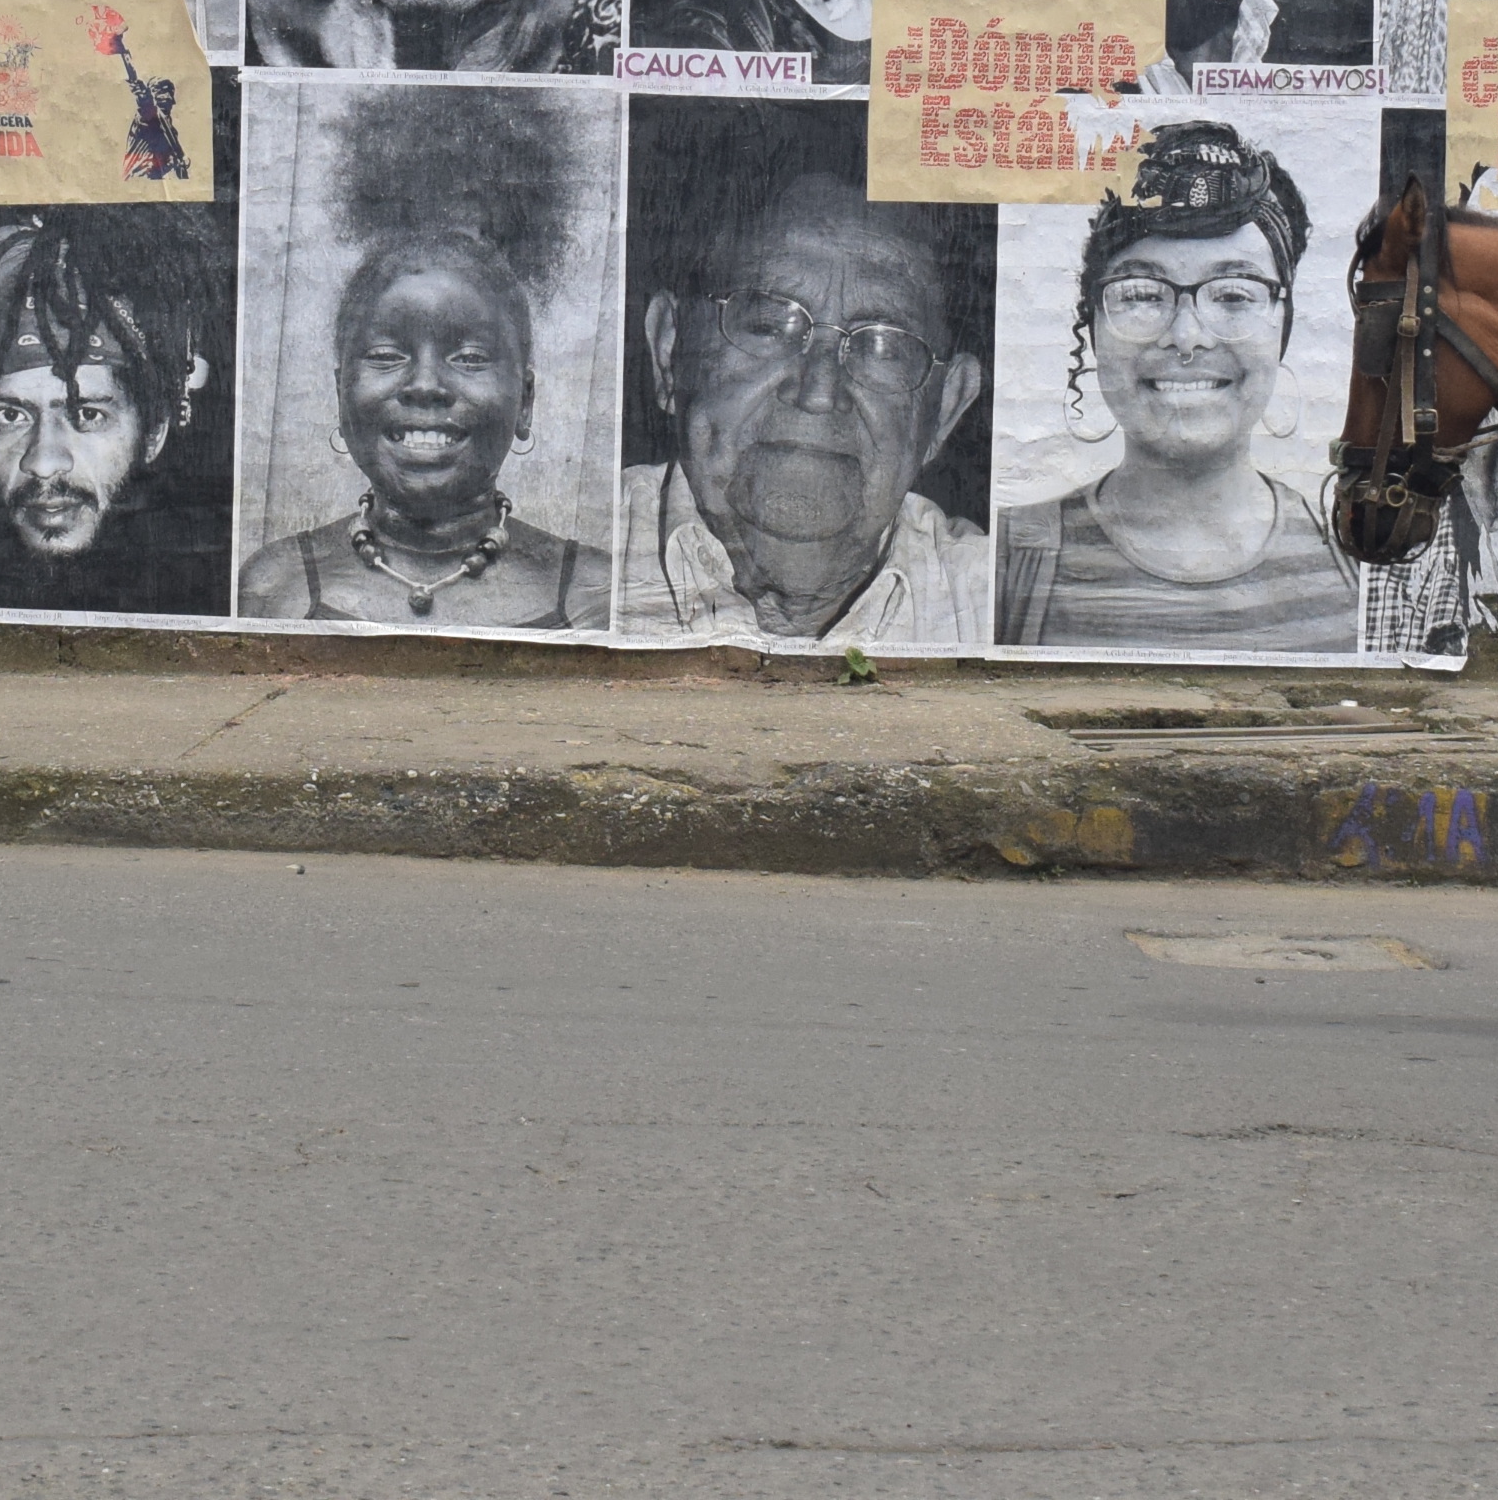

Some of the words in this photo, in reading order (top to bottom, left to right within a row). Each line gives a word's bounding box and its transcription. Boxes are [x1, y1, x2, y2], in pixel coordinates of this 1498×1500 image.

[617, 52, 726, 79] ¡CAUCA
[735, 56, 807, 83] VIVE!
[1197, 68, 1304, 95] ¡ESTAMOS
[1310, 68, 1385, 95] VIVOS!
